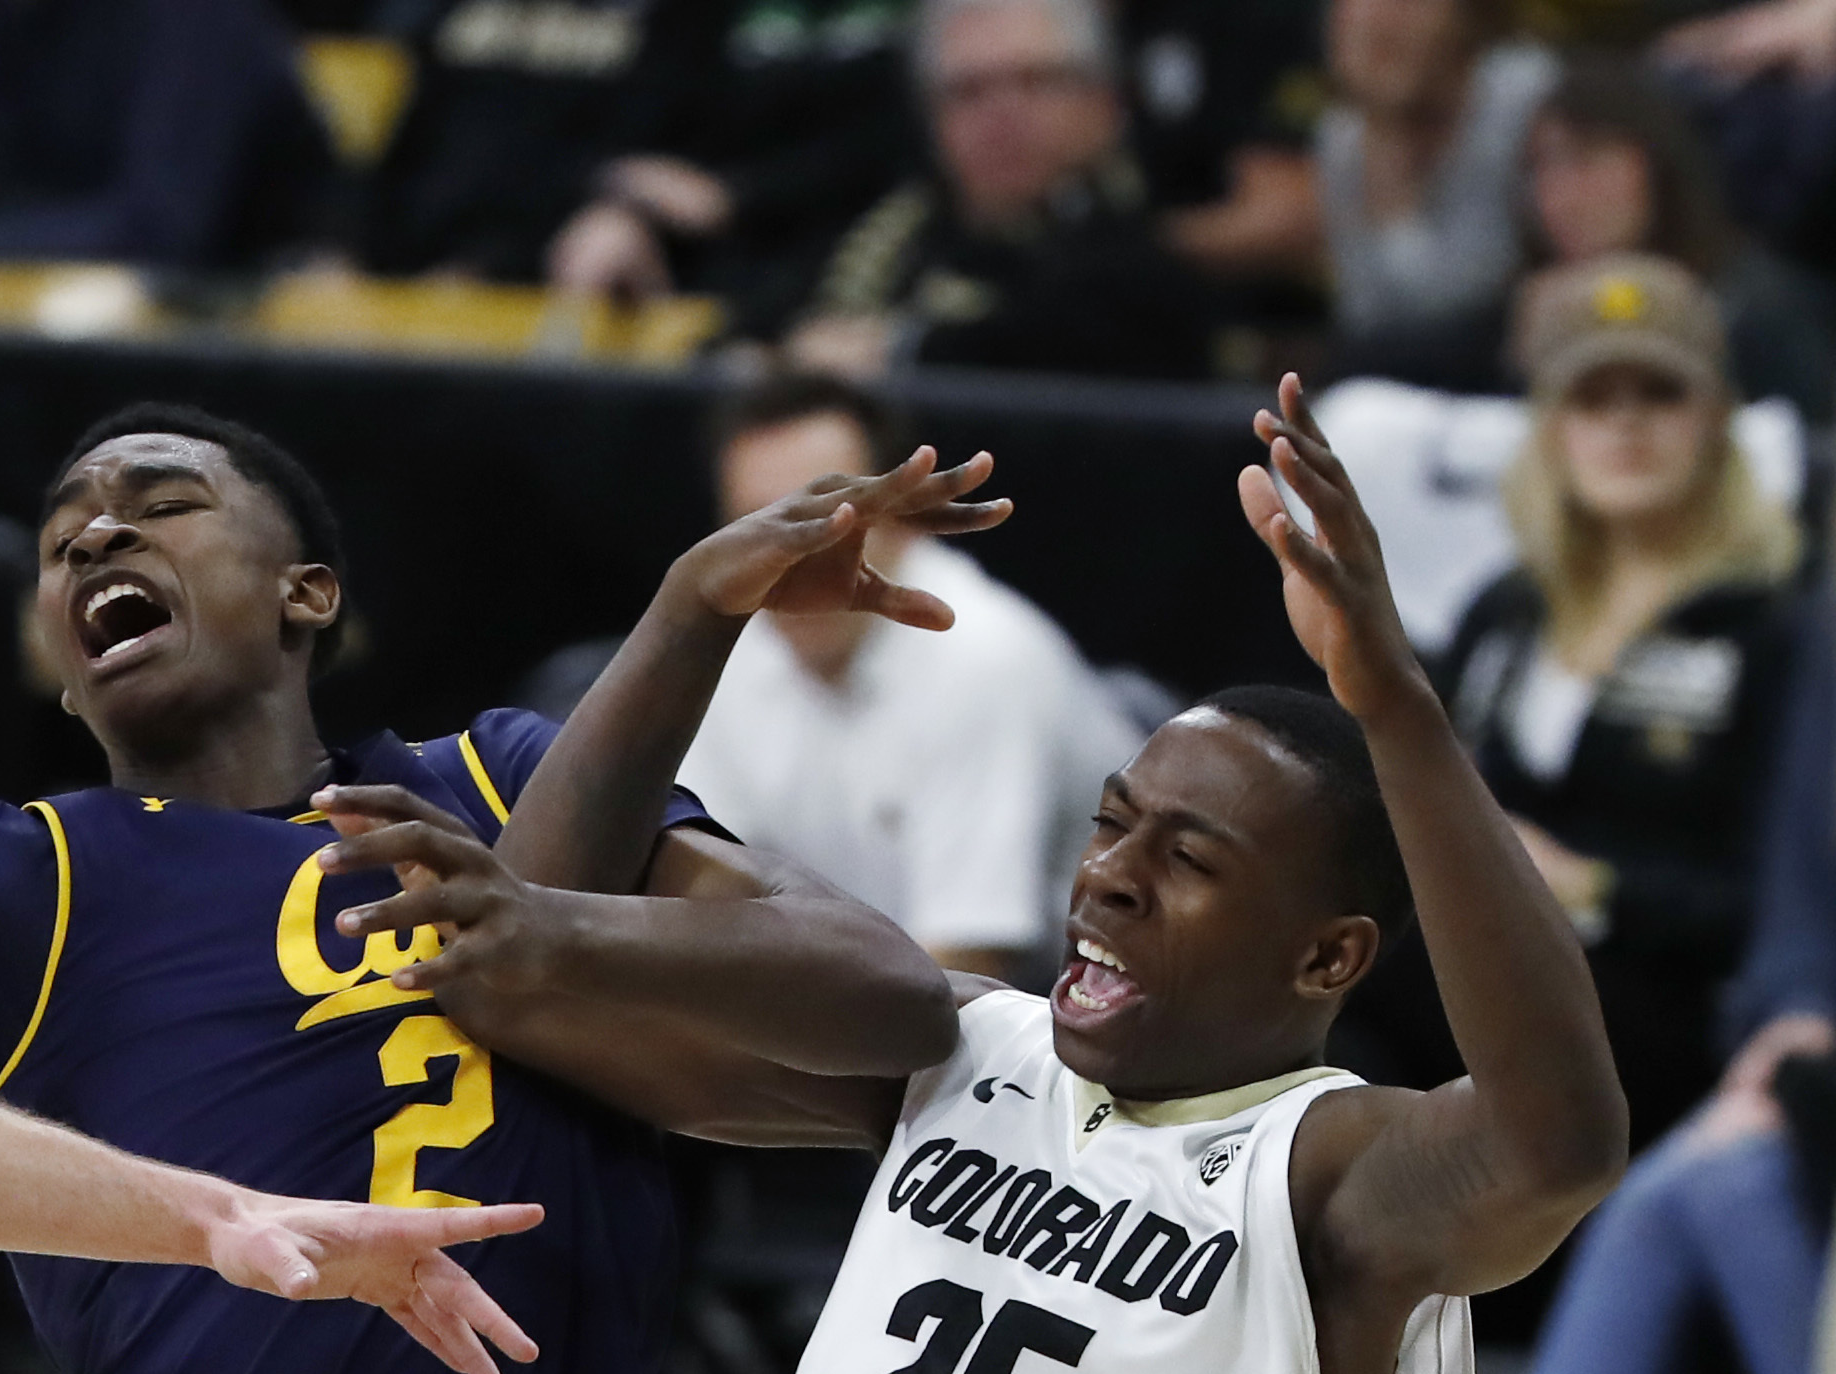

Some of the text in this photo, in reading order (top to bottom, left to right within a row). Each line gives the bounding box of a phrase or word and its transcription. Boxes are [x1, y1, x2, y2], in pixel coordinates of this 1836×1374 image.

[369, 1015, 495, 1210] 2
[1203, 1159, 1229, 1179] 12
[887, 1137, 1239, 1317] COLORADO
